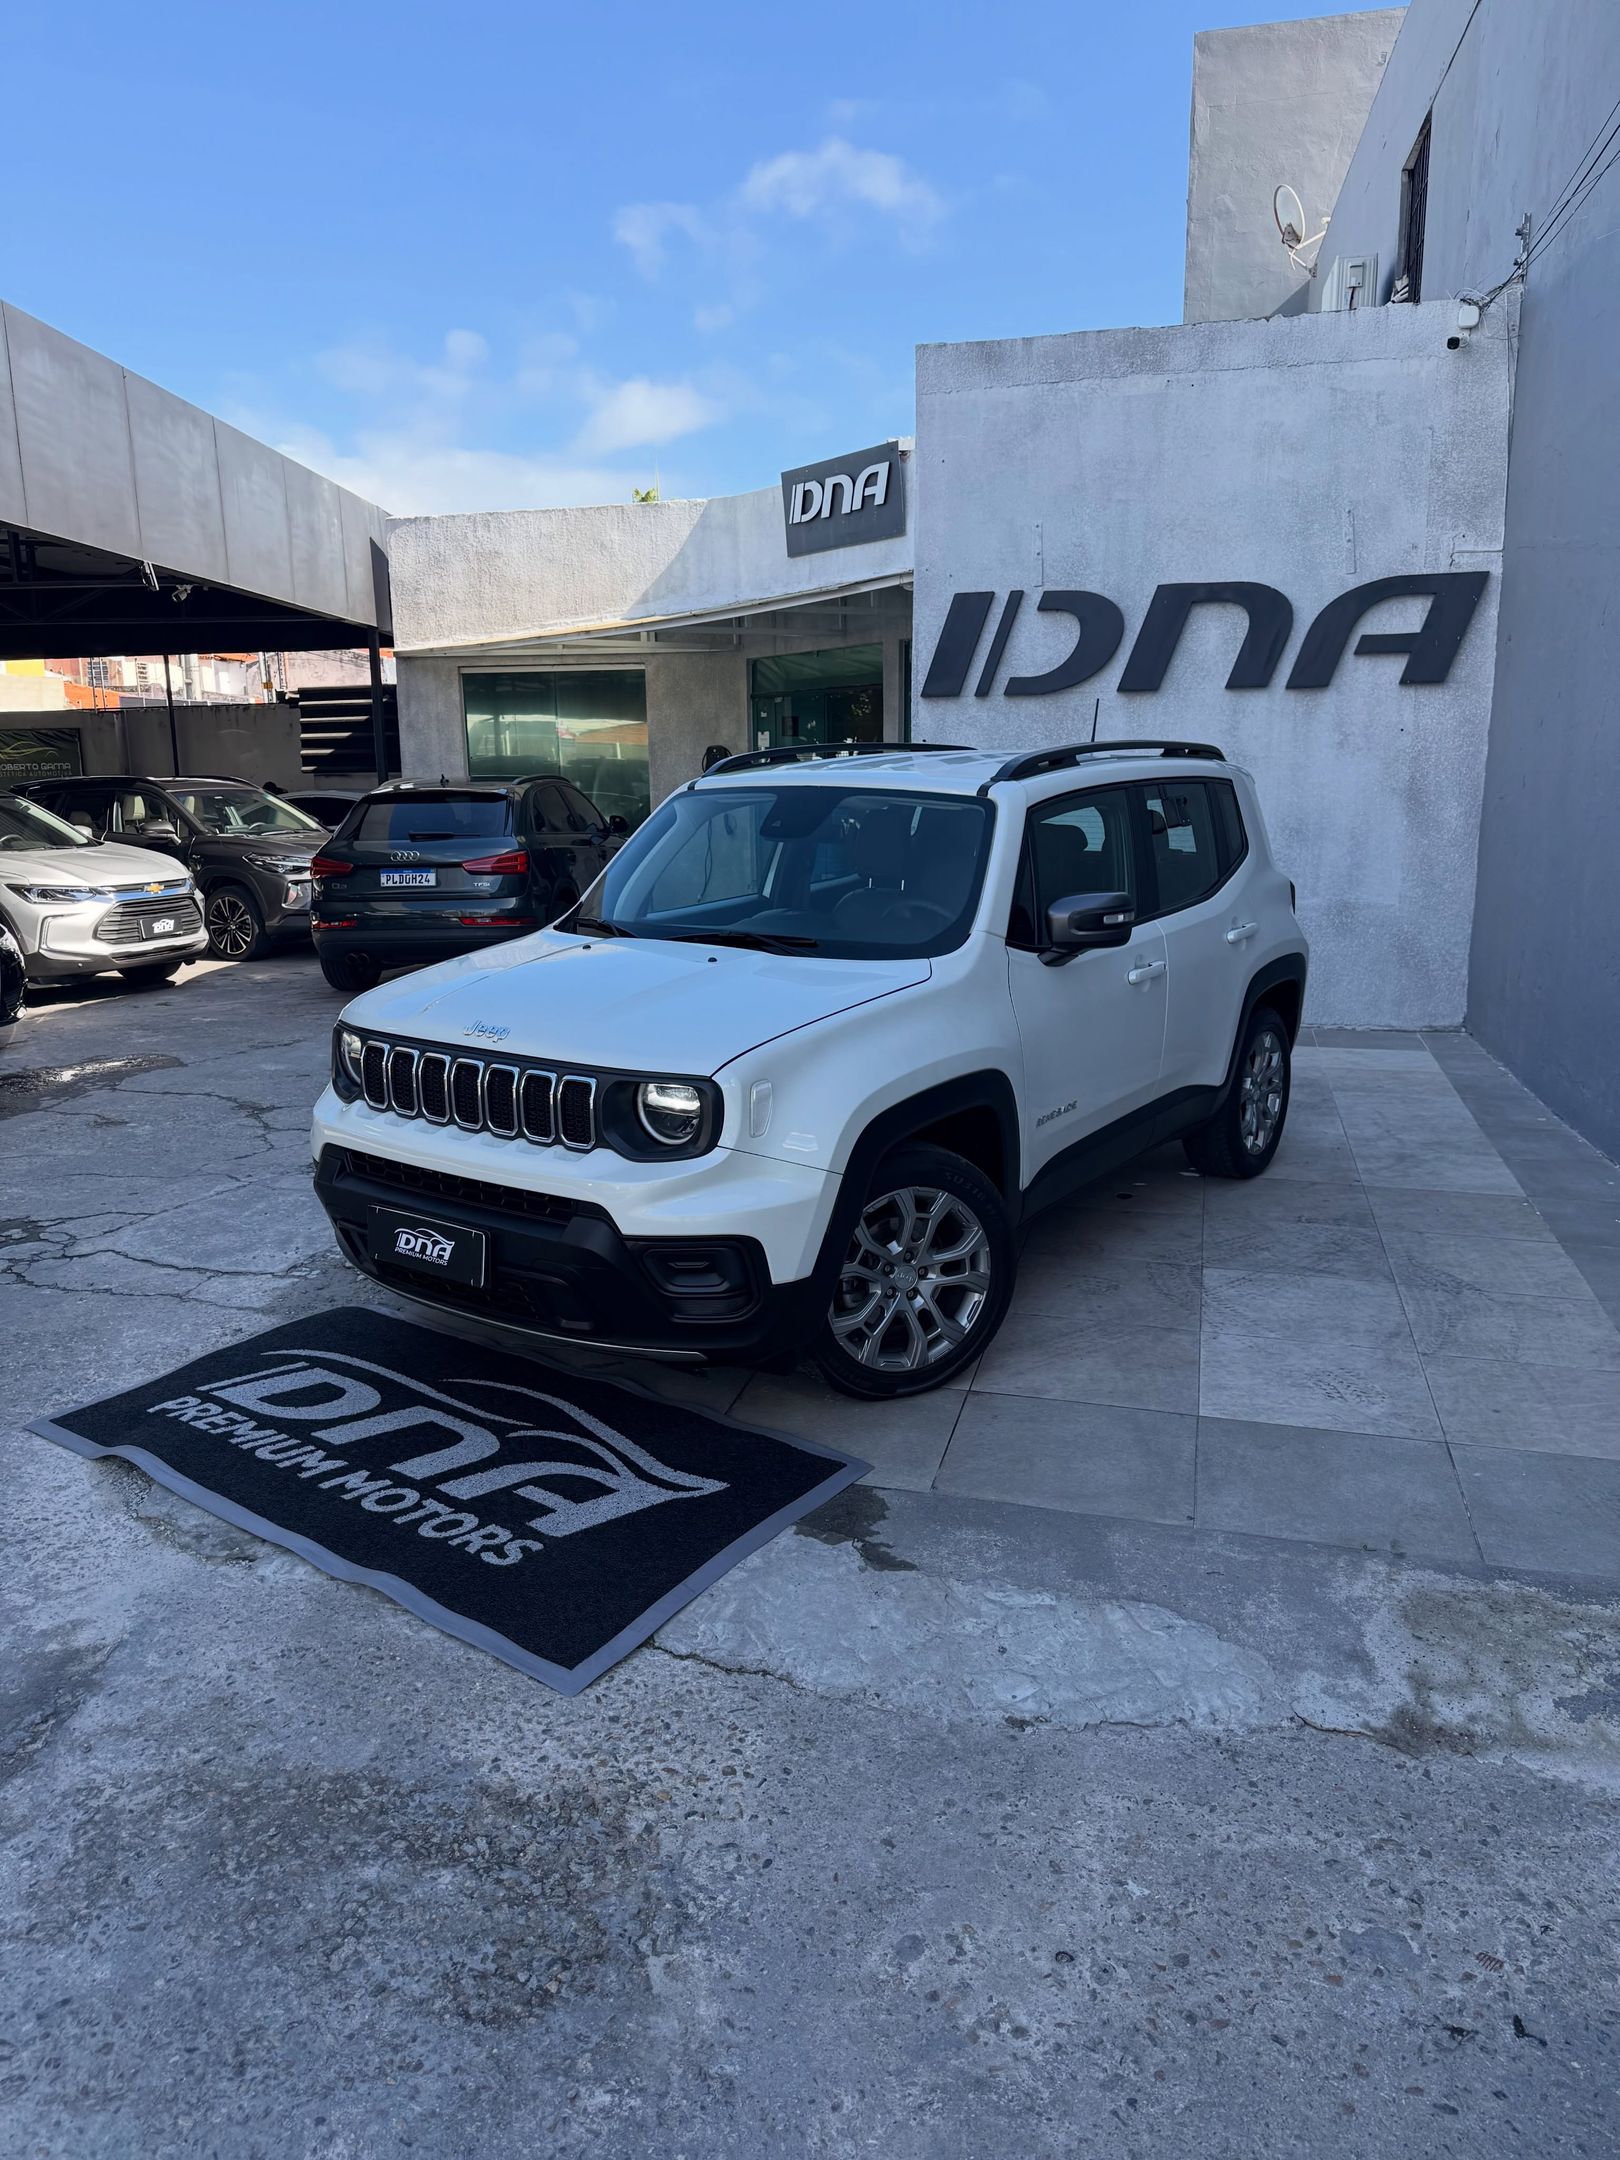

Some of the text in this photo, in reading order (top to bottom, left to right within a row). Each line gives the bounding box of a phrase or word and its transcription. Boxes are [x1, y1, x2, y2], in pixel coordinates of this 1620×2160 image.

[789, 461, 890, 525] DNA
[921, 571, 1490, 698] DNA
[0, 763, 39, 771] OBERTO
[463, 1019, 511, 1043] Jeep
[394, 1246, 449, 1267] PREMIUM MOTORS
[396, 1231, 454, 1261] DNA
[146, 1395, 545, 1566] PREMIUM MOTORS
